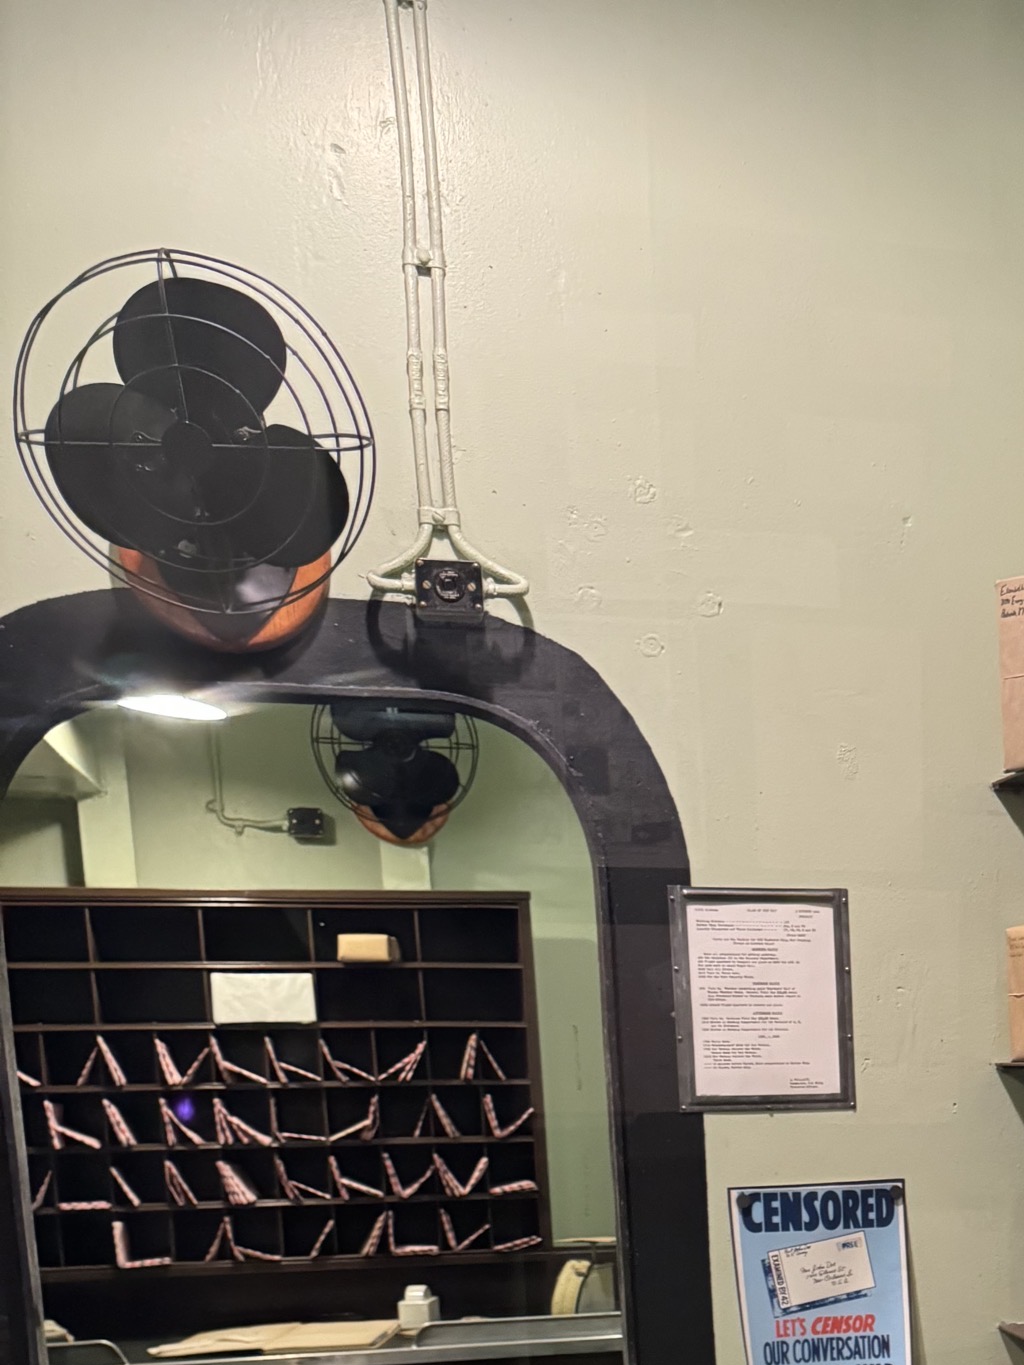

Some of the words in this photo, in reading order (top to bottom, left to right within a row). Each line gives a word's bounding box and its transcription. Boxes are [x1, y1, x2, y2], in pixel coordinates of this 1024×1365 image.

[742, 1187, 895, 1233] CENSORED
[775, 1317, 807, 1338] LET'S
[810, 1313, 876, 1336] CENSOR
[763, 1340, 790, 1365] OUR
[793, 1334, 891, 1364] CONVERSATION
